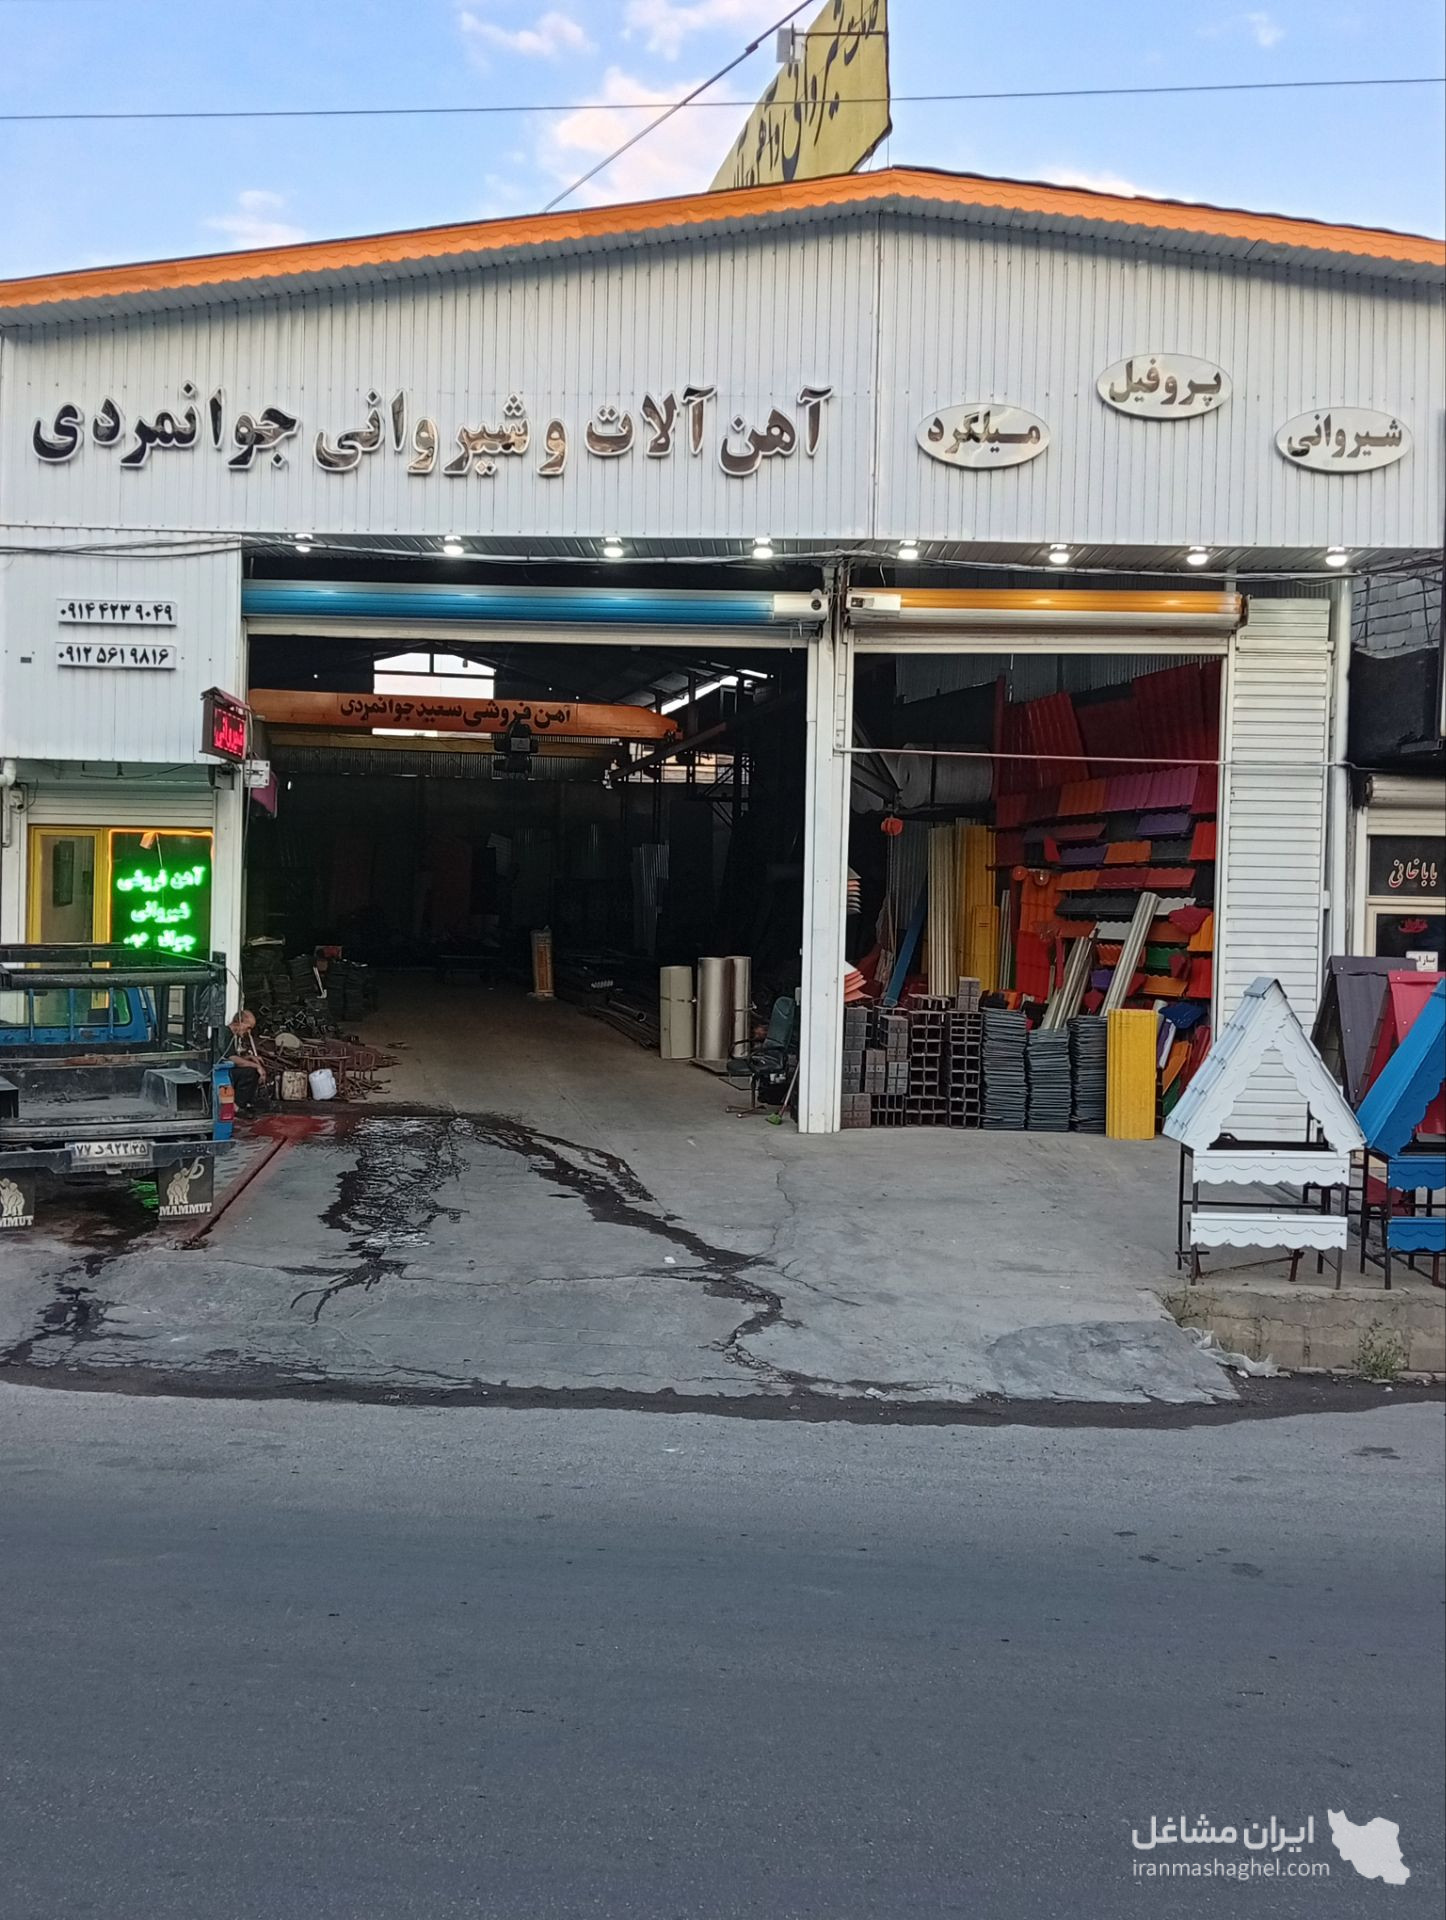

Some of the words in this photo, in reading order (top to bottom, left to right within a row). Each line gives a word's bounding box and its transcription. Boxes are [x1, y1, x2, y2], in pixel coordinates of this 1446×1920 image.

[1109, 357, 1222, 406] پروفیل
[32, 379, 302, 469] جوانمردی
[312, 387, 532, 477] شیروانی
[585, 384, 717, 458] آلات
[718, 384, 834, 478] آهن
[926, 409, 1042, 455] میلگرد
[536, 416, 569, 477] و
[1286, 413, 1404, 459] شیروانی
[60, 602, 96, 620] ۰۹۱۴
[98, 602, 131, 621] ۴۲۳
[135, 604, 173, 622] ۹۰۴۹
[58, 645, 92, 663] ۰۹۱۲
[96, 646, 125, 664] ۵۶۱
[130, 647, 169, 666] ۹۸۱۶
[340, 696, 416, 721] جوانمردی
[416, 706, 463, 723] سعید
[462, 700, 531, 727] فروشی
[534, 704, 571, 728] آهن
[118, 870, 167, 891] فروشی
[171, 867, 204, 889] آهن
[131, 901, 190, 922] شیروانی
[159, 1202, 213, 1217] MAMMUT
